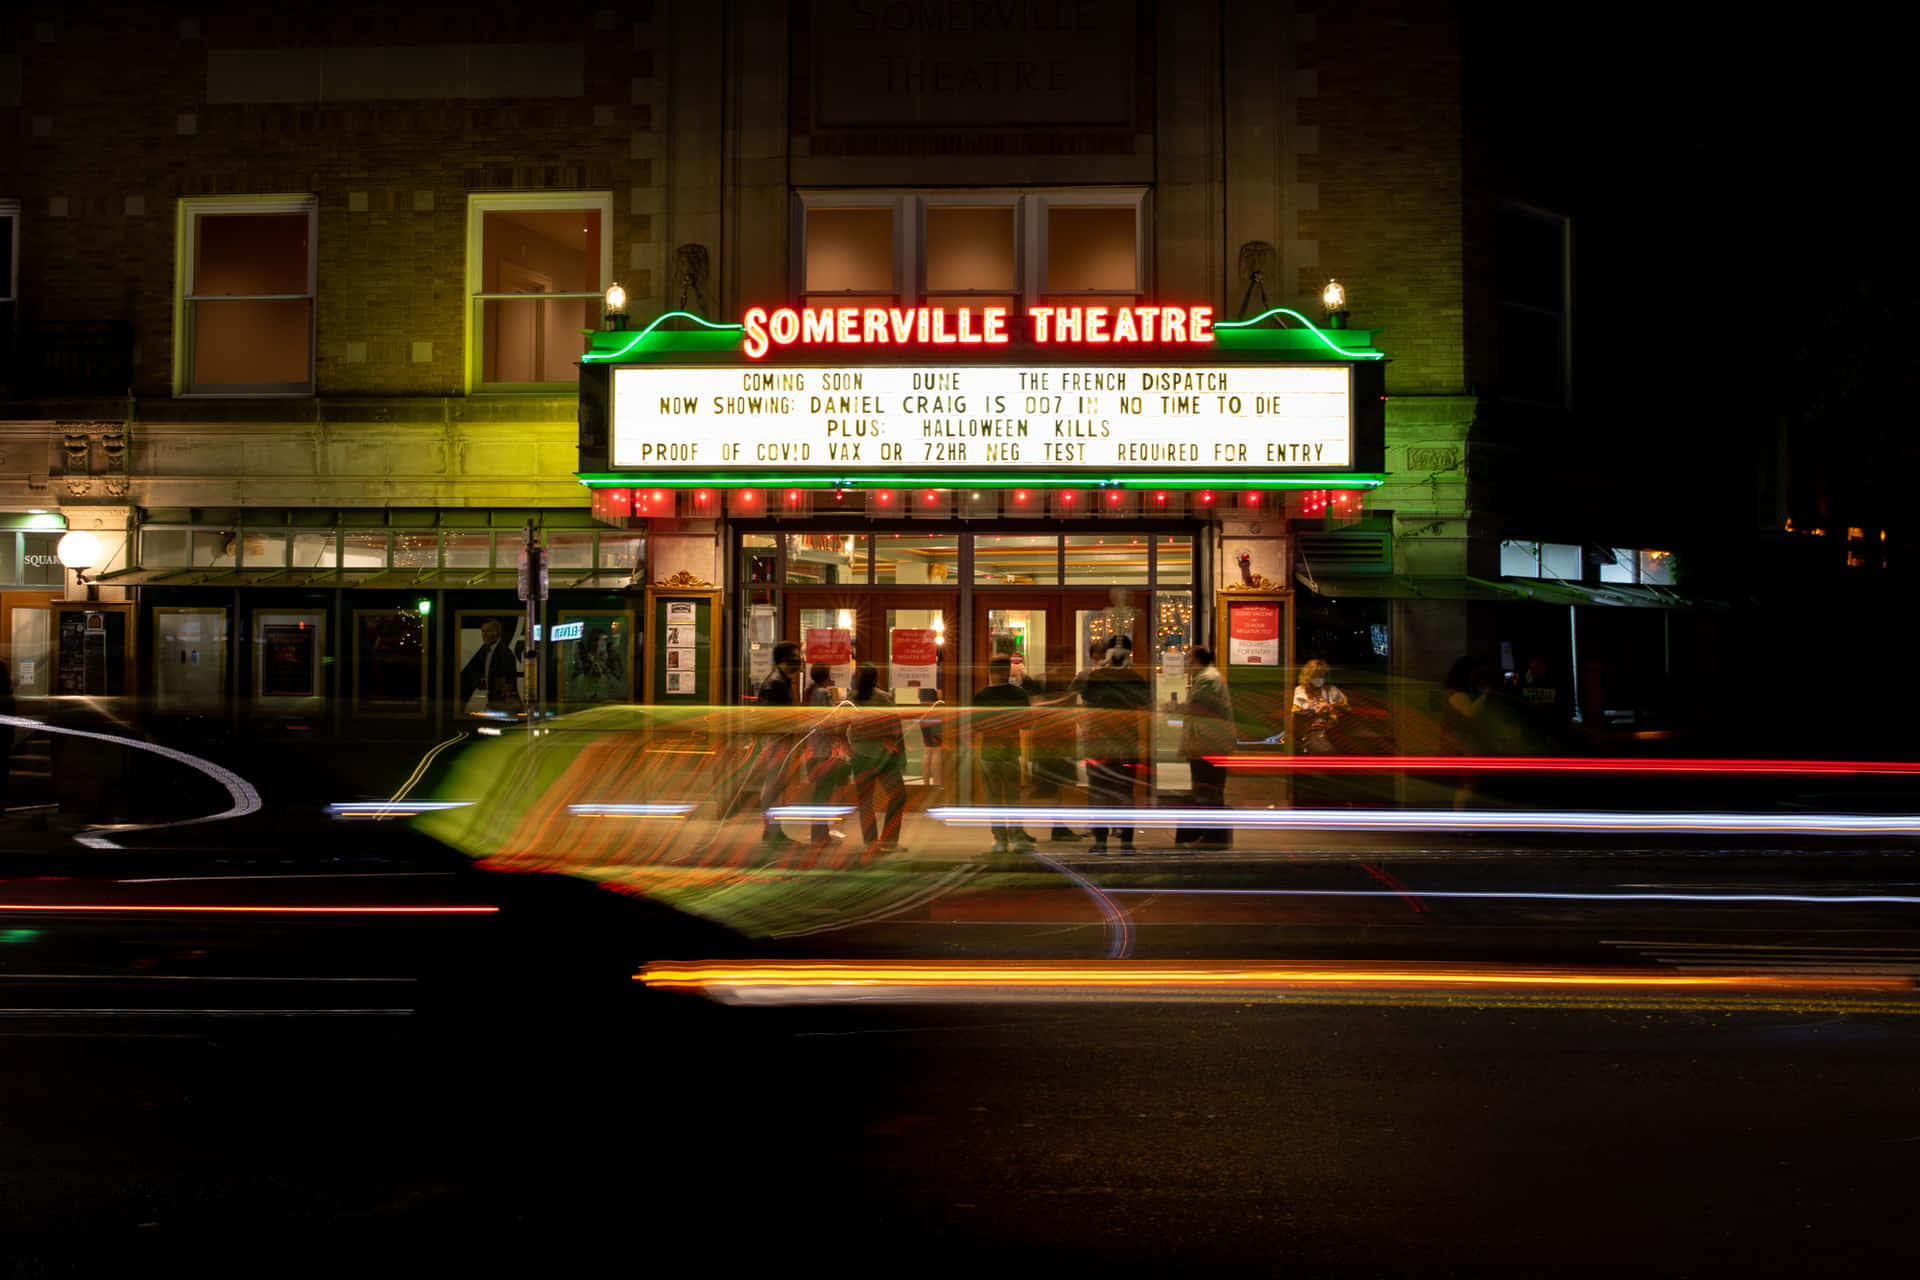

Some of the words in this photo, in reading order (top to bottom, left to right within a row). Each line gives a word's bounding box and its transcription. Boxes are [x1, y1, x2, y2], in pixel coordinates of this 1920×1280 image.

[880, 55, 1066, 95] THEATRE
[743, 306, 1009, 358] SOMERVILLE
[1030, 306, 1216, 344] THEATRE
[743, 372, 805, 392] COMING
[822, 372, 863, 392] SOON
[913, 372, 960, 392] DUNE
[1019, 372, 1049, 392] THE
[1062, 372, 1126, 392] FRENCH
[1141, 372, 1227, 392] DISPATCH
[659, 396, 698, 415] NOW
[810, 396, 885, 415] DANIEL
[902, 396, 967, 415] CRAIG
[985, 396, 1006, 415] IS
[1078, 396, 1098, 415] IN
[1120, 396, 1142, 415] NO
[1160, 396, 1201, 415] TIME
[1217, 396, 1242, 415] TO
[1255, 396, 1281, 415] DIE
[923, 419, 1028, 438] HALLOWEEN
[1055, 419, 1110, 438] KILLS
[641, 443, 699, 462] PROOF
[722, 443, 740, 462] OF
[828, 443, 861, 462] VAX
[880, 443, 903, 462] OR
[924, 443, 967, 462] 72HR
[986, 443, 1021, 462] NEG
[1044, 443, 1086, 462] TEST
[1117, 443, 1199, 462] REQUIRED
[1214, 443, 1247, 462] FOR
[1266, 443, 1324, 462] ENTRY
